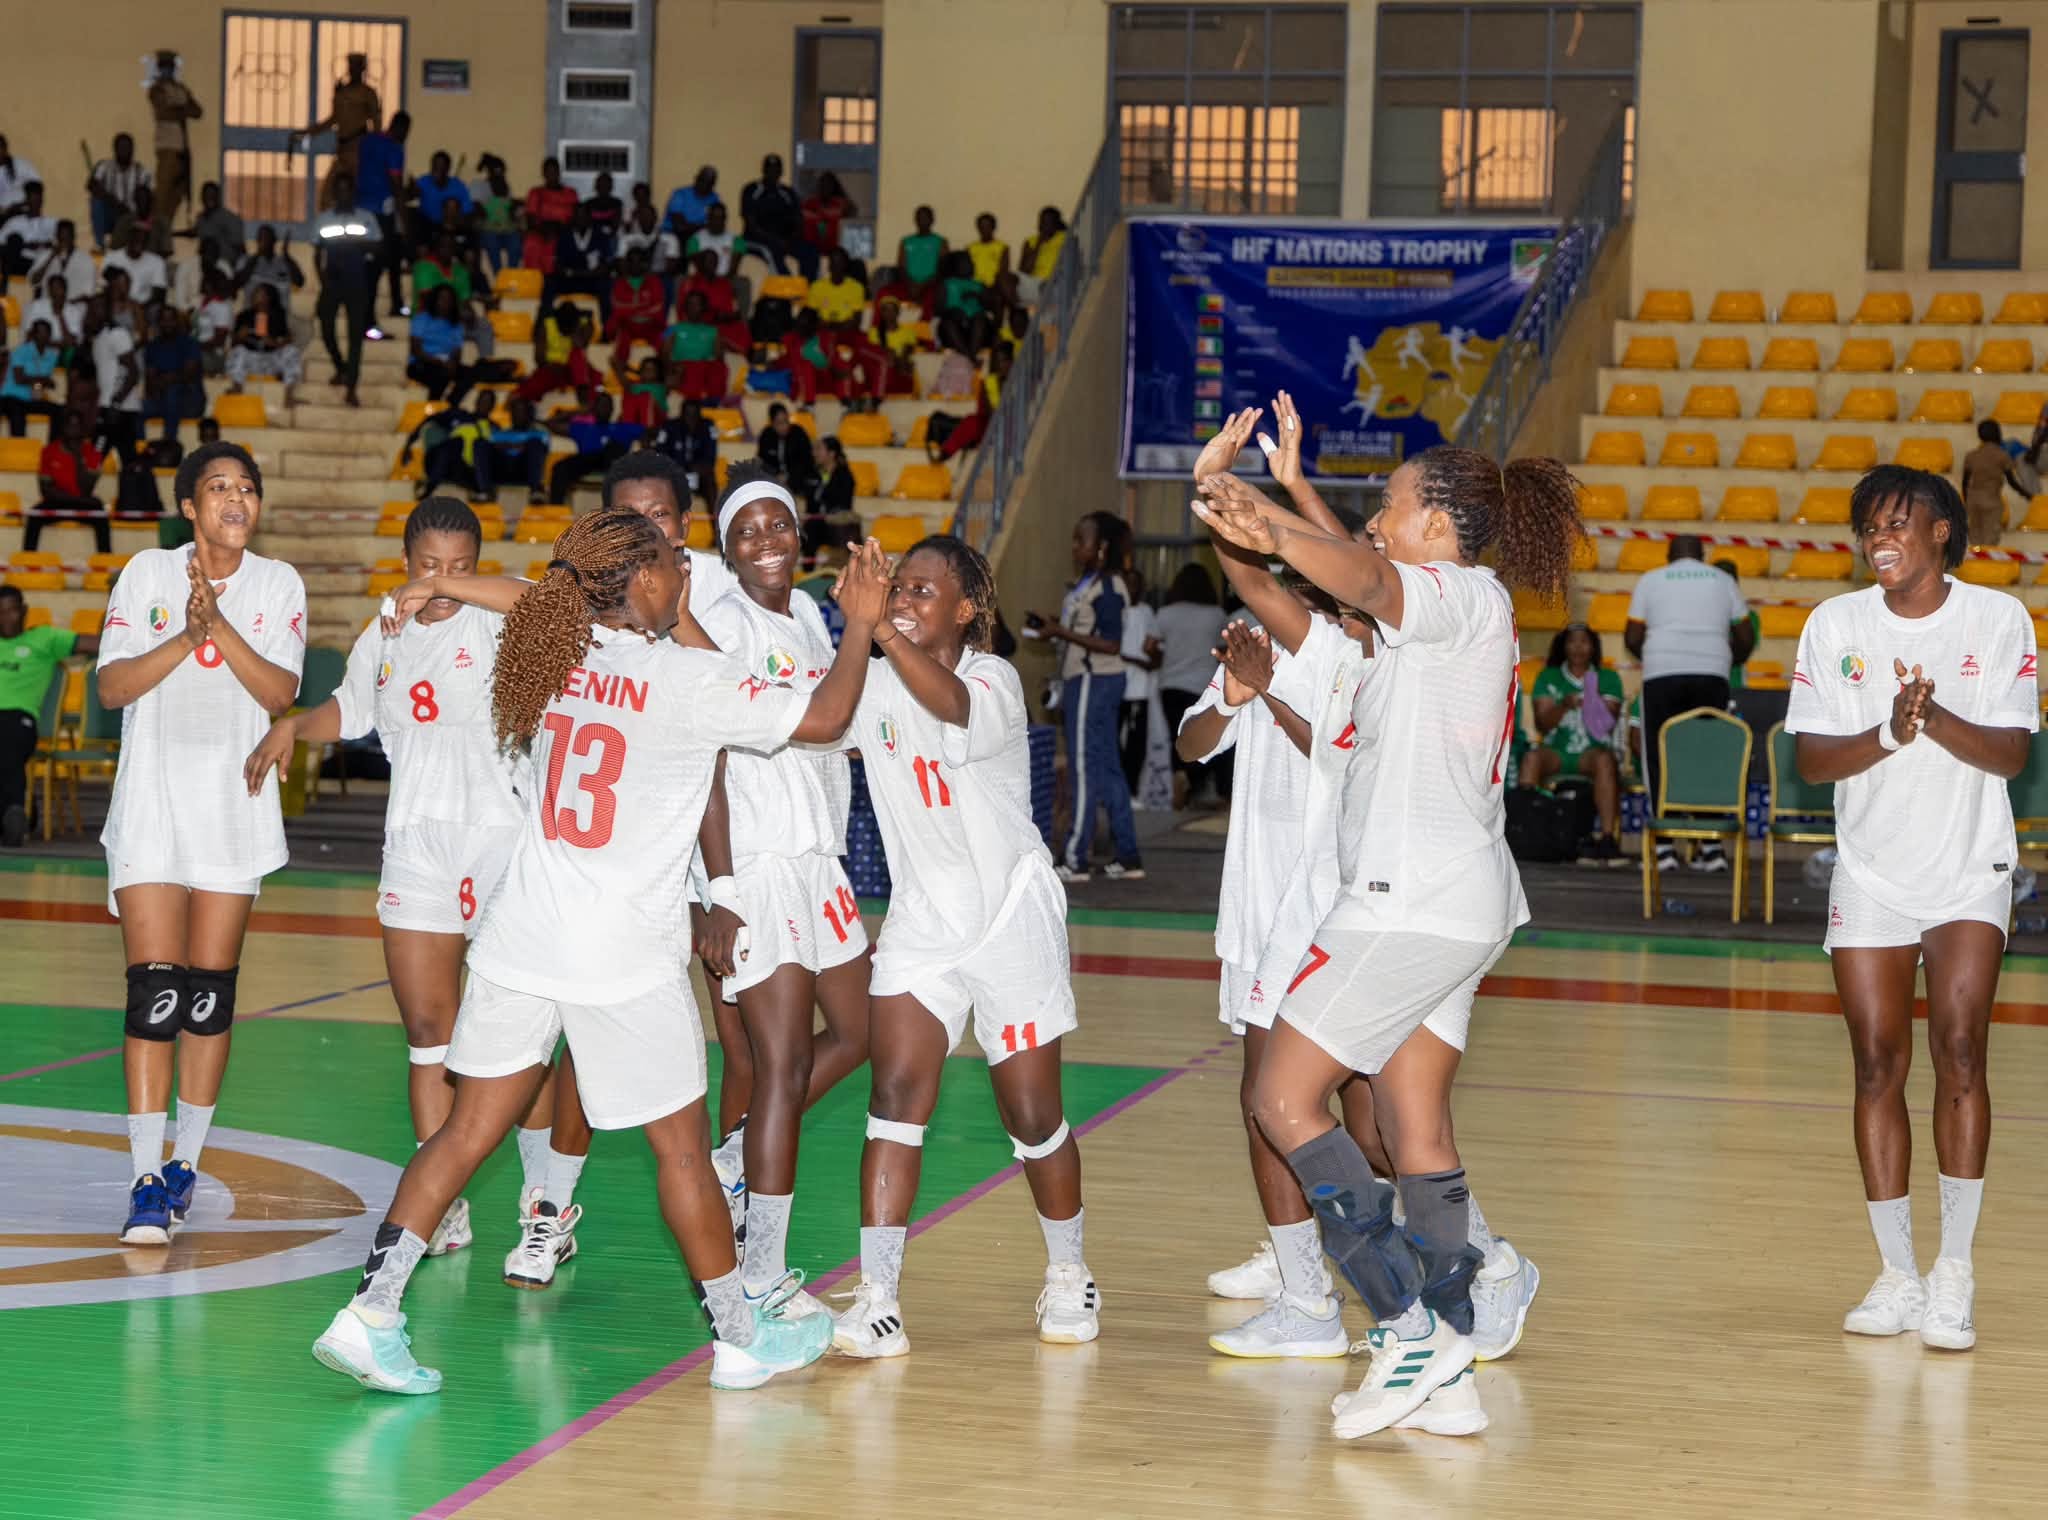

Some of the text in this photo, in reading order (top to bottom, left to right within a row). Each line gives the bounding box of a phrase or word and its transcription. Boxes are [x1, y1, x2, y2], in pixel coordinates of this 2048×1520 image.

[1232, 237, 1273, 263] IHF
[1275, 238, 1384, 264] NATIONS
[1389, 240, 1488, 265] TROPHY
[409, 680, 439, 722] 8
[562, 666, 649, 712] ENIN
[541, 712, 627, 849] 13
[912, 755, 951, 808] 11
[459, 876, 477, 920] 8
[823, 884, 862, 944] 14
[1001, 1021, 1037, 1052] 11
